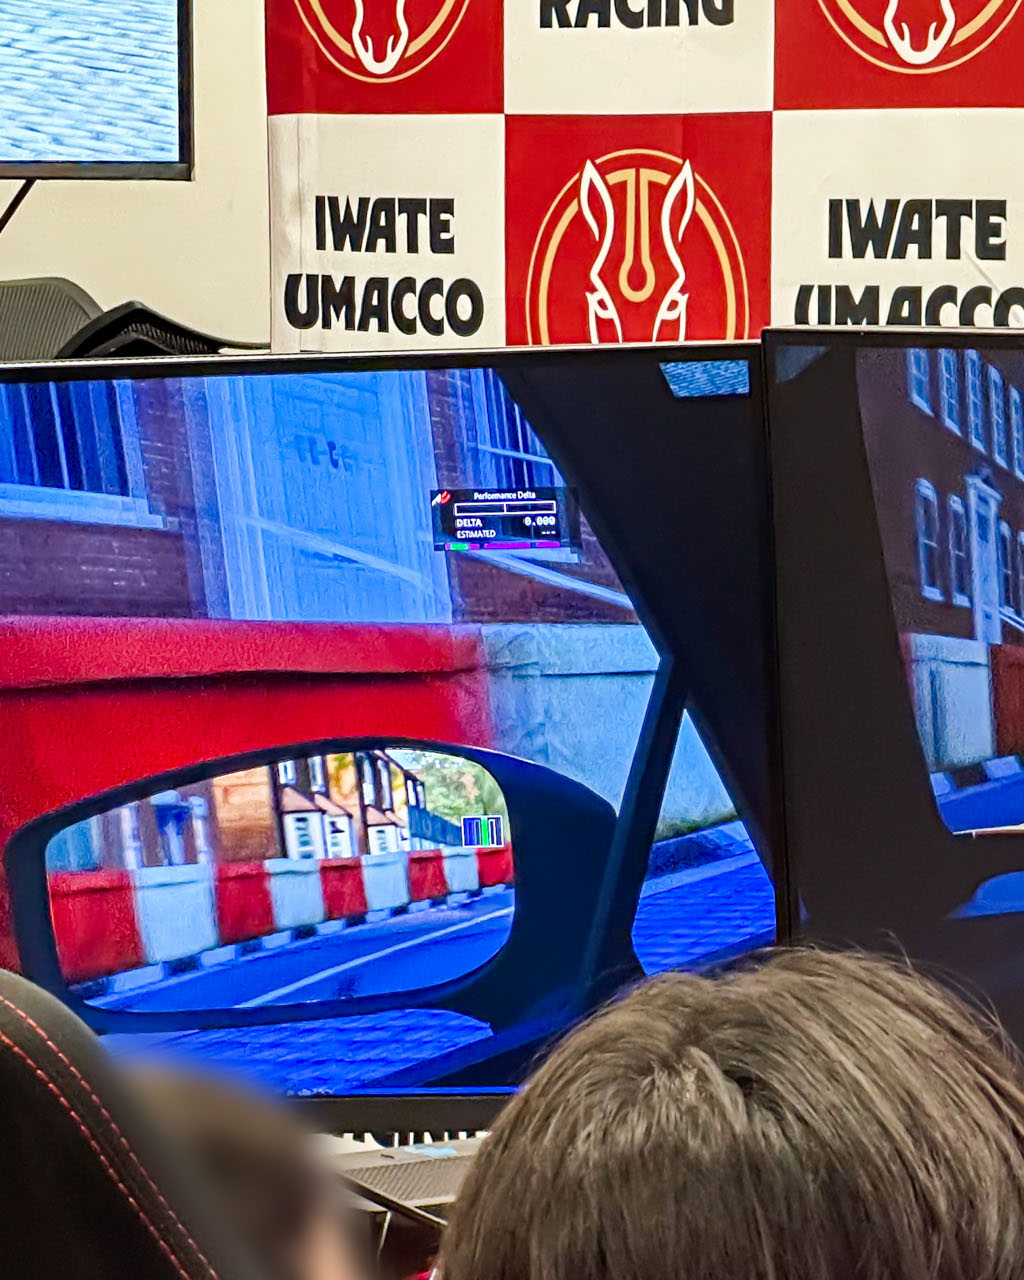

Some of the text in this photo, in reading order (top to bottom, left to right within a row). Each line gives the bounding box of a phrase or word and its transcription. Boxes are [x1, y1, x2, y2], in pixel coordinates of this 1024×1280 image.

[315, 195, 455, 255] IWATE
[828, 199, 1007, 261] IWATE
[284, 274, 484, 337] UMACCO
[473, 490, 537, 500] Performance Delta
[456, 516, 556, 528] DELTA 0.000
[456, 529, 497, 539] ESTIMATED
